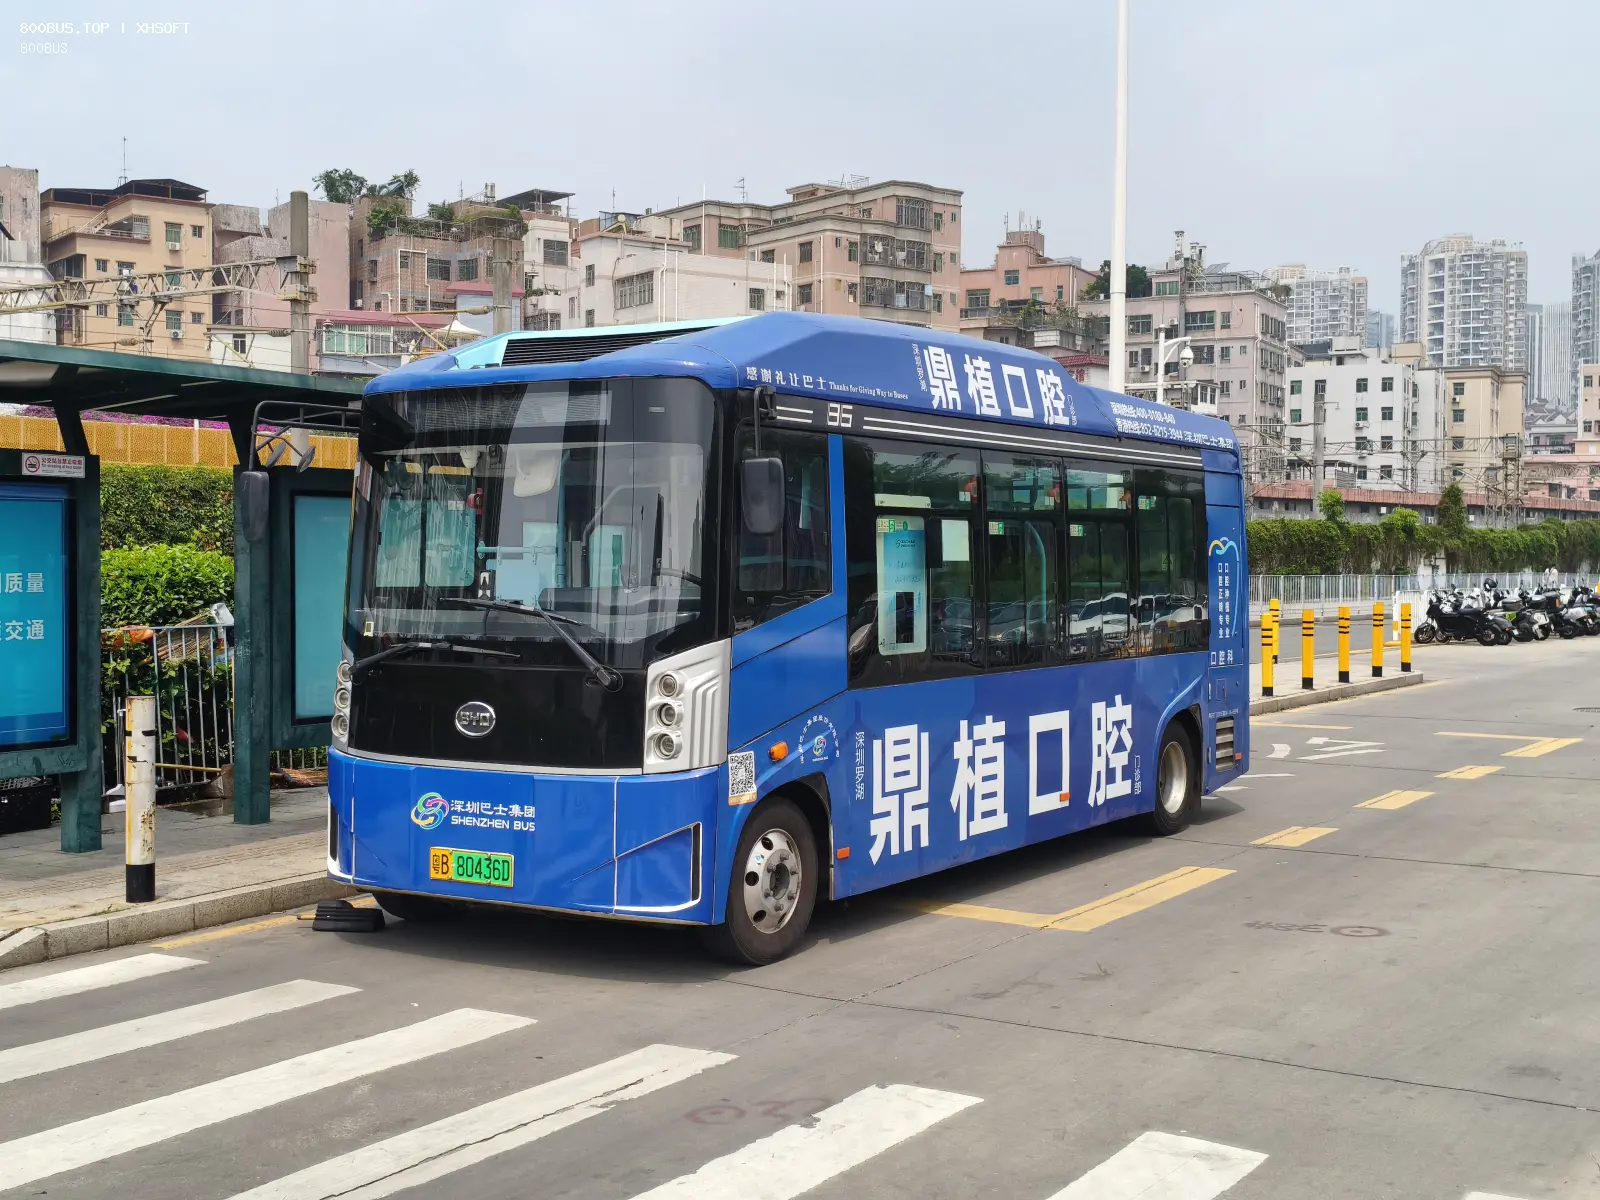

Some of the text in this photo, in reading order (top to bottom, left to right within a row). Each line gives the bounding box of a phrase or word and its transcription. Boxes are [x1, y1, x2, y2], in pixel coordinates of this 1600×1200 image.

[746, 366, 827, 391] 感谢礼让巴士
[923, 345, 1070, 426] 鼎植口腔
[829, 381, 909, 400] Thanks for Giving Way to Buses
[1184, 430, 1234, 450] 深圳巴士集团
[0, 572, 45, 593] 质量
[0, 620, 45, 641] 交通
[1210, 649, 1234, 666] 口腔科
[460, 711, 490, 727] BYD
[868, 694, 1134, 866] 鼎植口腔
[450, 799, 536, 819] 深圳巴士集团
[450, 815, 536, 832] SHENZHEN BUS
